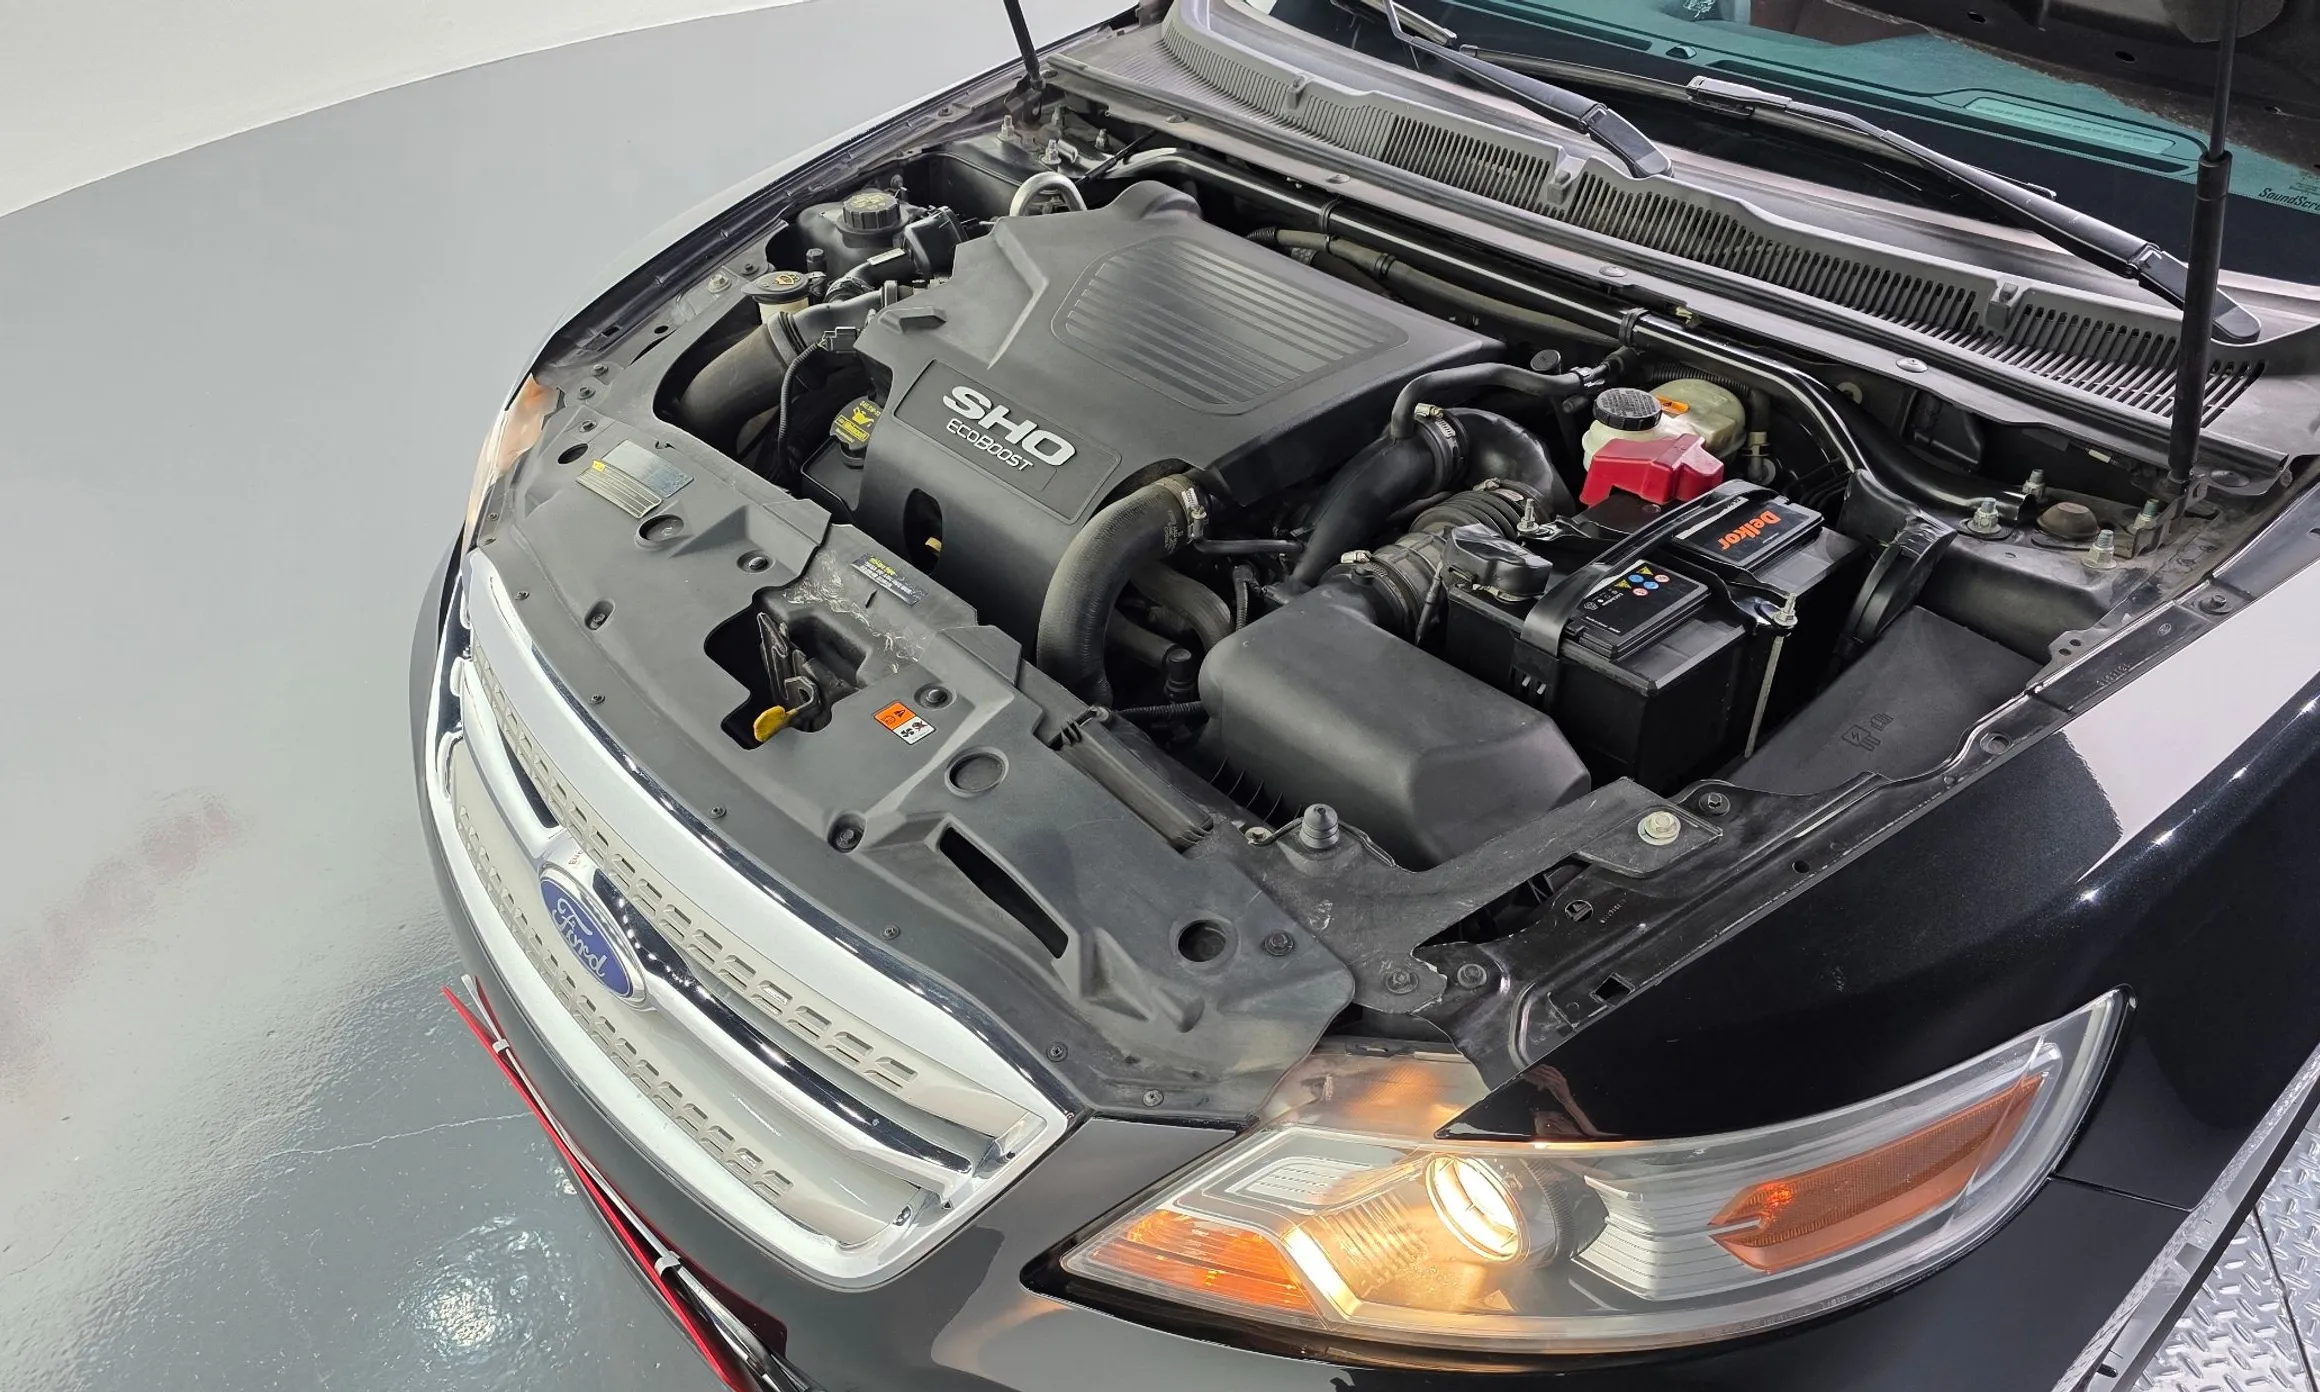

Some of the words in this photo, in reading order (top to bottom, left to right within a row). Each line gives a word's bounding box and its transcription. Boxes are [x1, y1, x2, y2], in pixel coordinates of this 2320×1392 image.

[942, 385, 1077, 466] SHO
[1717, 510, 1781, 551] Delkor
[551, 897, 608, 978] Ford
